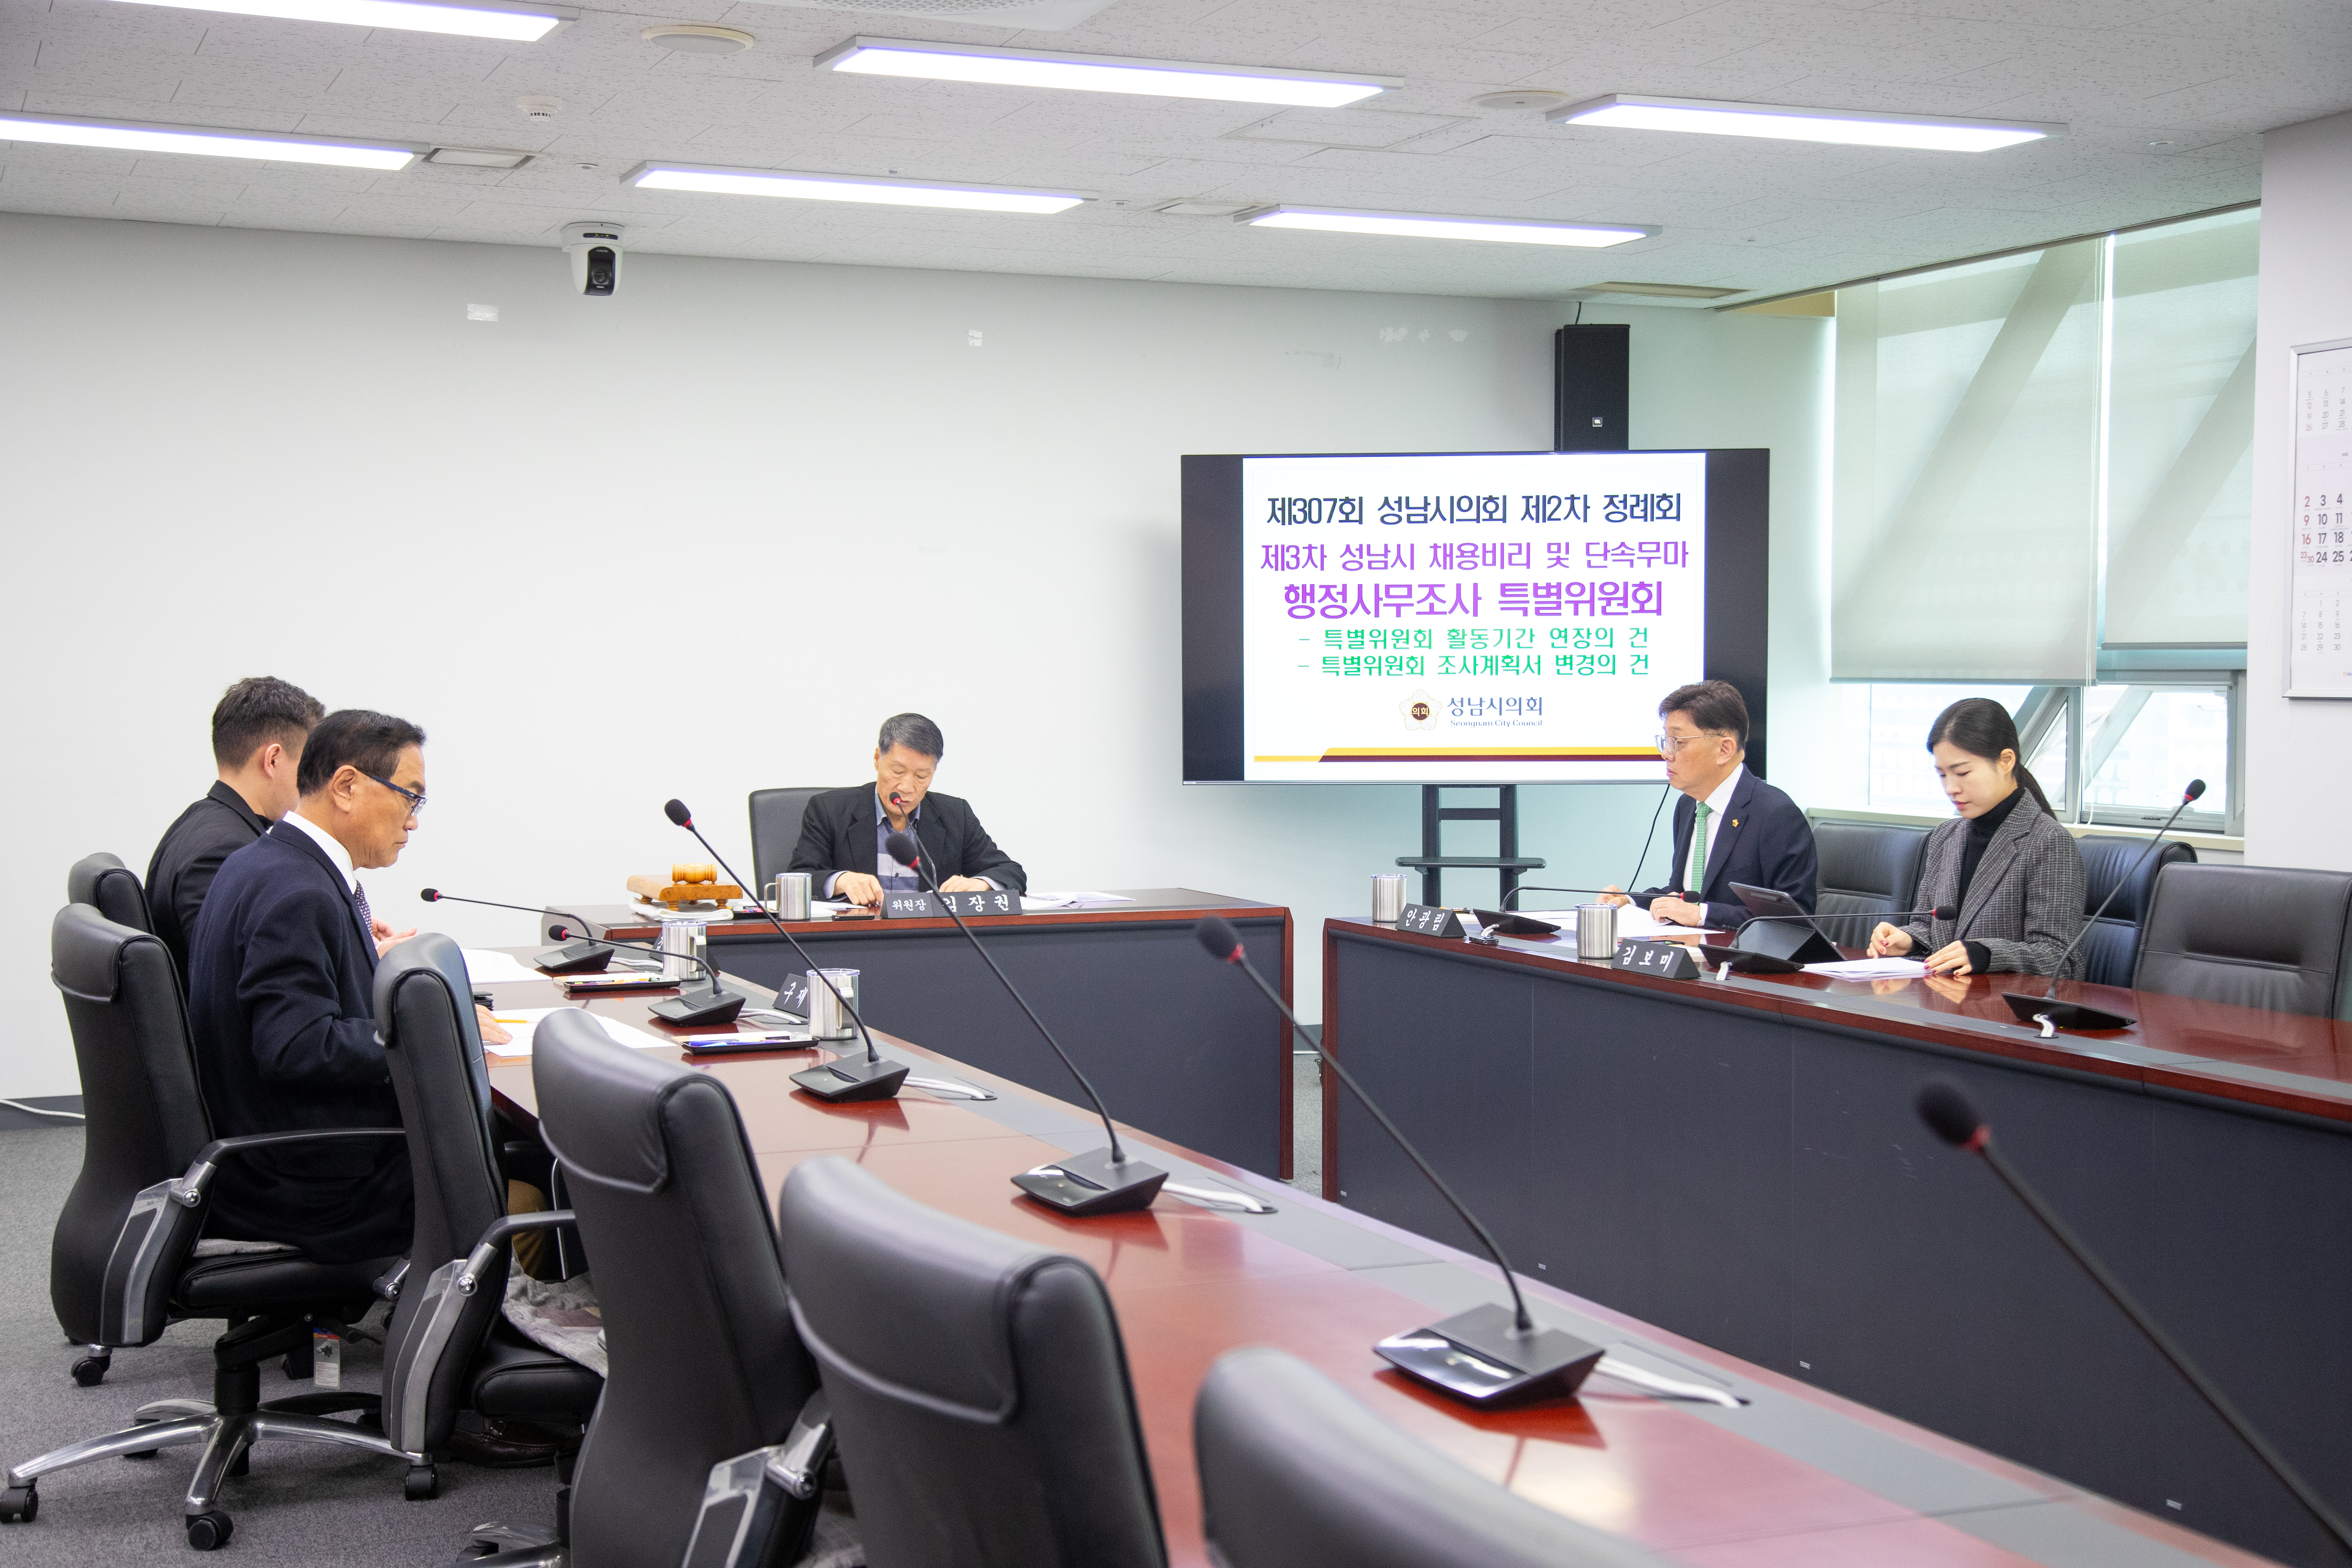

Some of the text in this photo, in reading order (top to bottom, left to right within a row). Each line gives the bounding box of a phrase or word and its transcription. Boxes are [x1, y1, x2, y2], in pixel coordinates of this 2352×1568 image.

[1267, 493, 1681, 526] 제307회 성남시의회 제2차 정례회
[2305, 493, 2343, 507] 2 3 4
[2304, 513, 2343, 526] 9 10 11
[2302, 532, 2344, 545] 16 17 18
[1261, 541, 1689, 571] 제3차 성남시 채용비리 및 단속무마
[2316, 552, 2328, 563] 24
[2333, 551, 2344, 562] 25
[1284, 581, 1662, 619] 행정사무조사 특별위원회
[1324, 629, 1432, 650] 특별위원회
[1447, 628, 1535, 649] 활동기간
[1550, 628, 1613, 649] 연장의
[1629, 628, 1647, 648] 건
[1322, 655, 1424, 677] 특별위원회
[1438, 655, 1541, 676] 조사계획서
[1556, 654, 1616, 676] 변경의
[1630, 654, 1648, 675] 건
[1412, 707, 1428, 716] 의회
[1448, 697, 1542, 717] 성남시의회
[1495, 720, 1510, 728] City
[892, 899, 926, 911] 위원장
[1406, 908, 1445, 931] 안광림
[1623, 945, 1673, 972] 김보미
